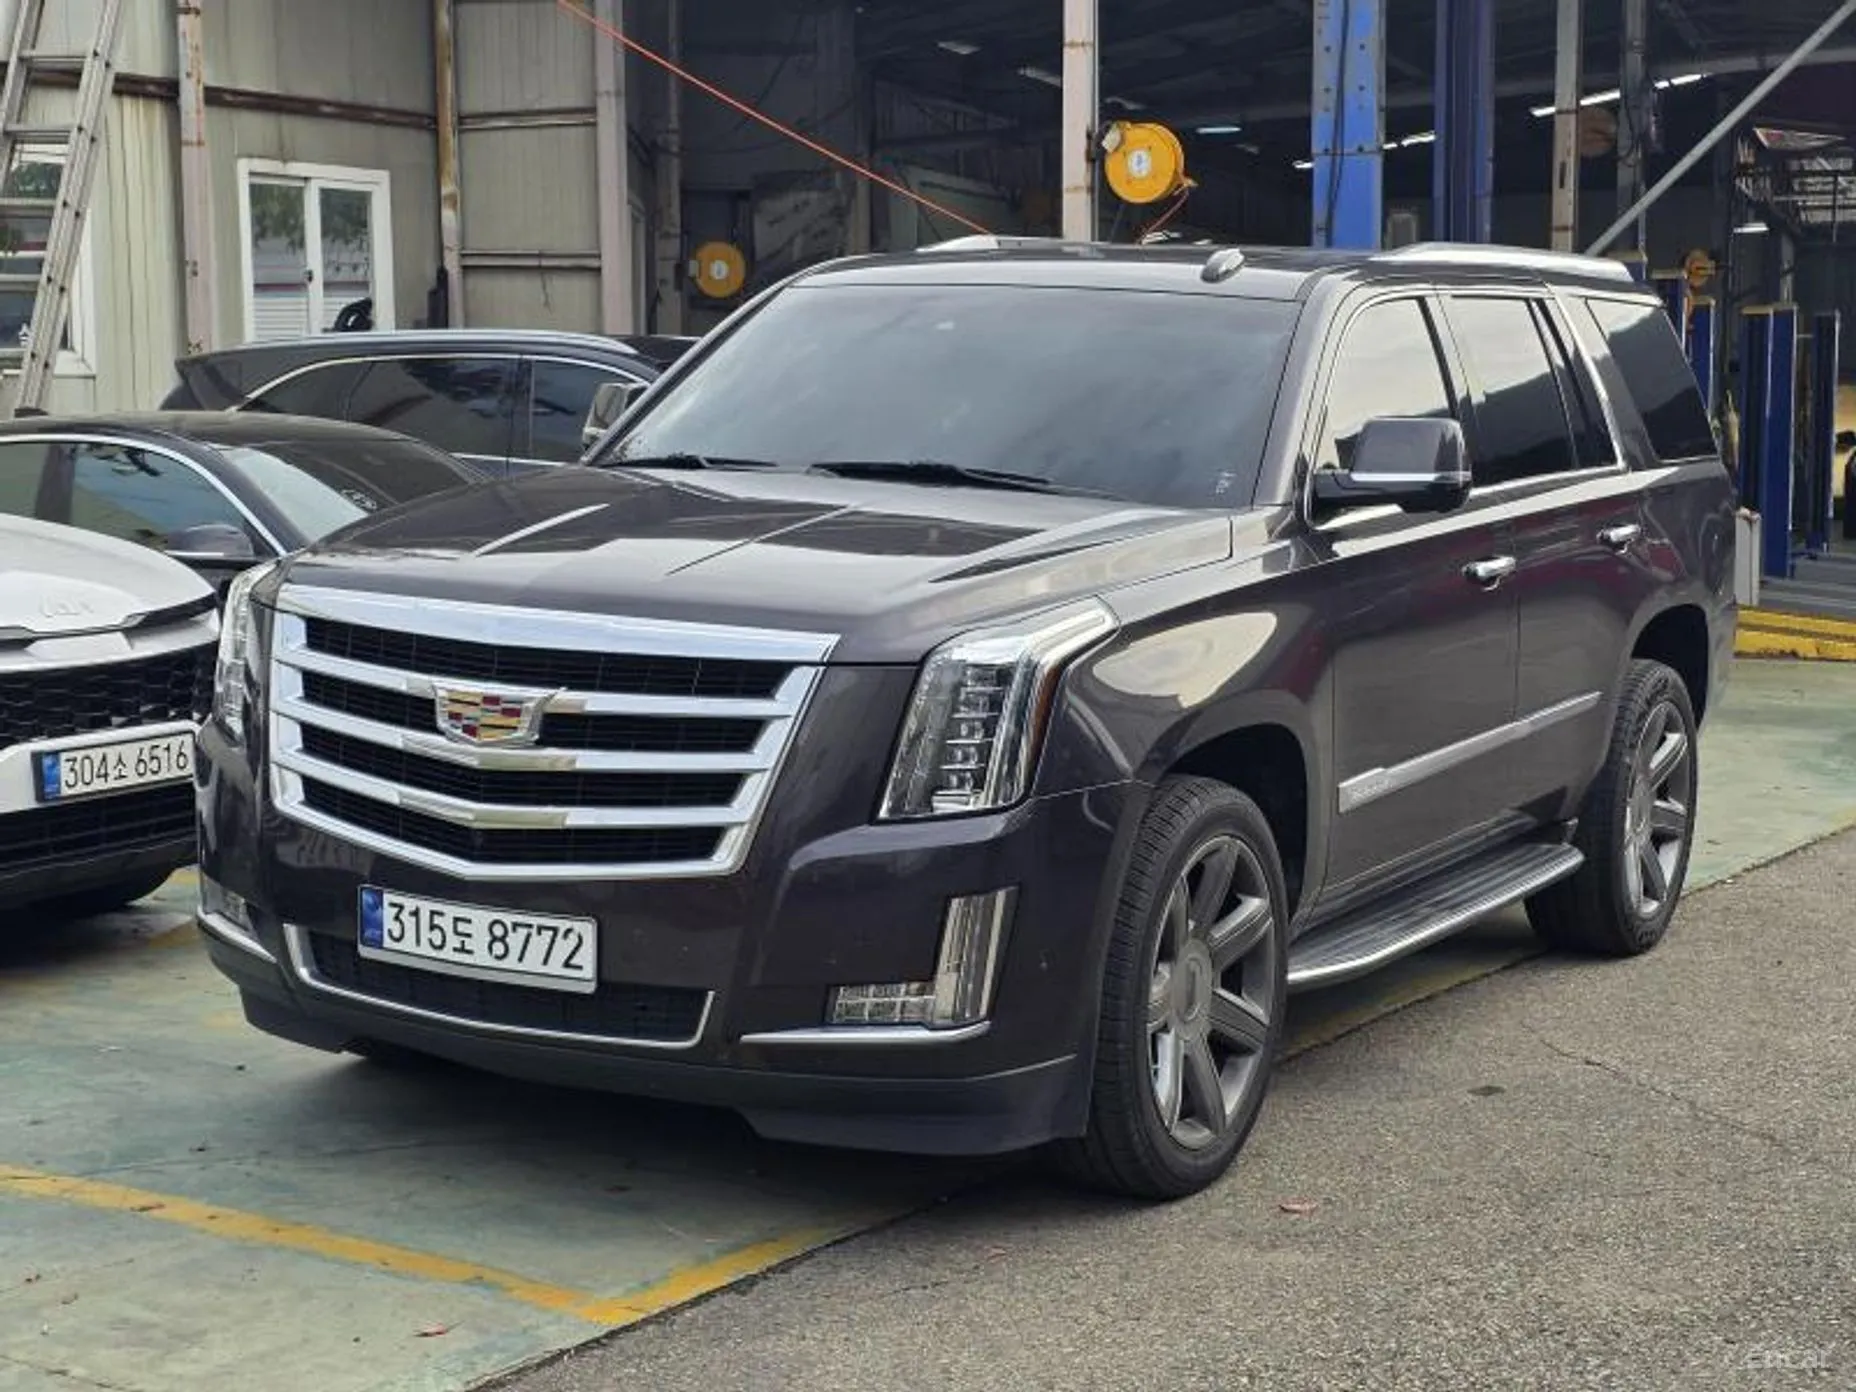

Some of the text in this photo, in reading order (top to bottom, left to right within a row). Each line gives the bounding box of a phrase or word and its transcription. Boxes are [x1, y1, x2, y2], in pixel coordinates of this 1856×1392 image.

[135, 740, 189, 778] 6516
[387, 901, 584, 971] 315도 8772
